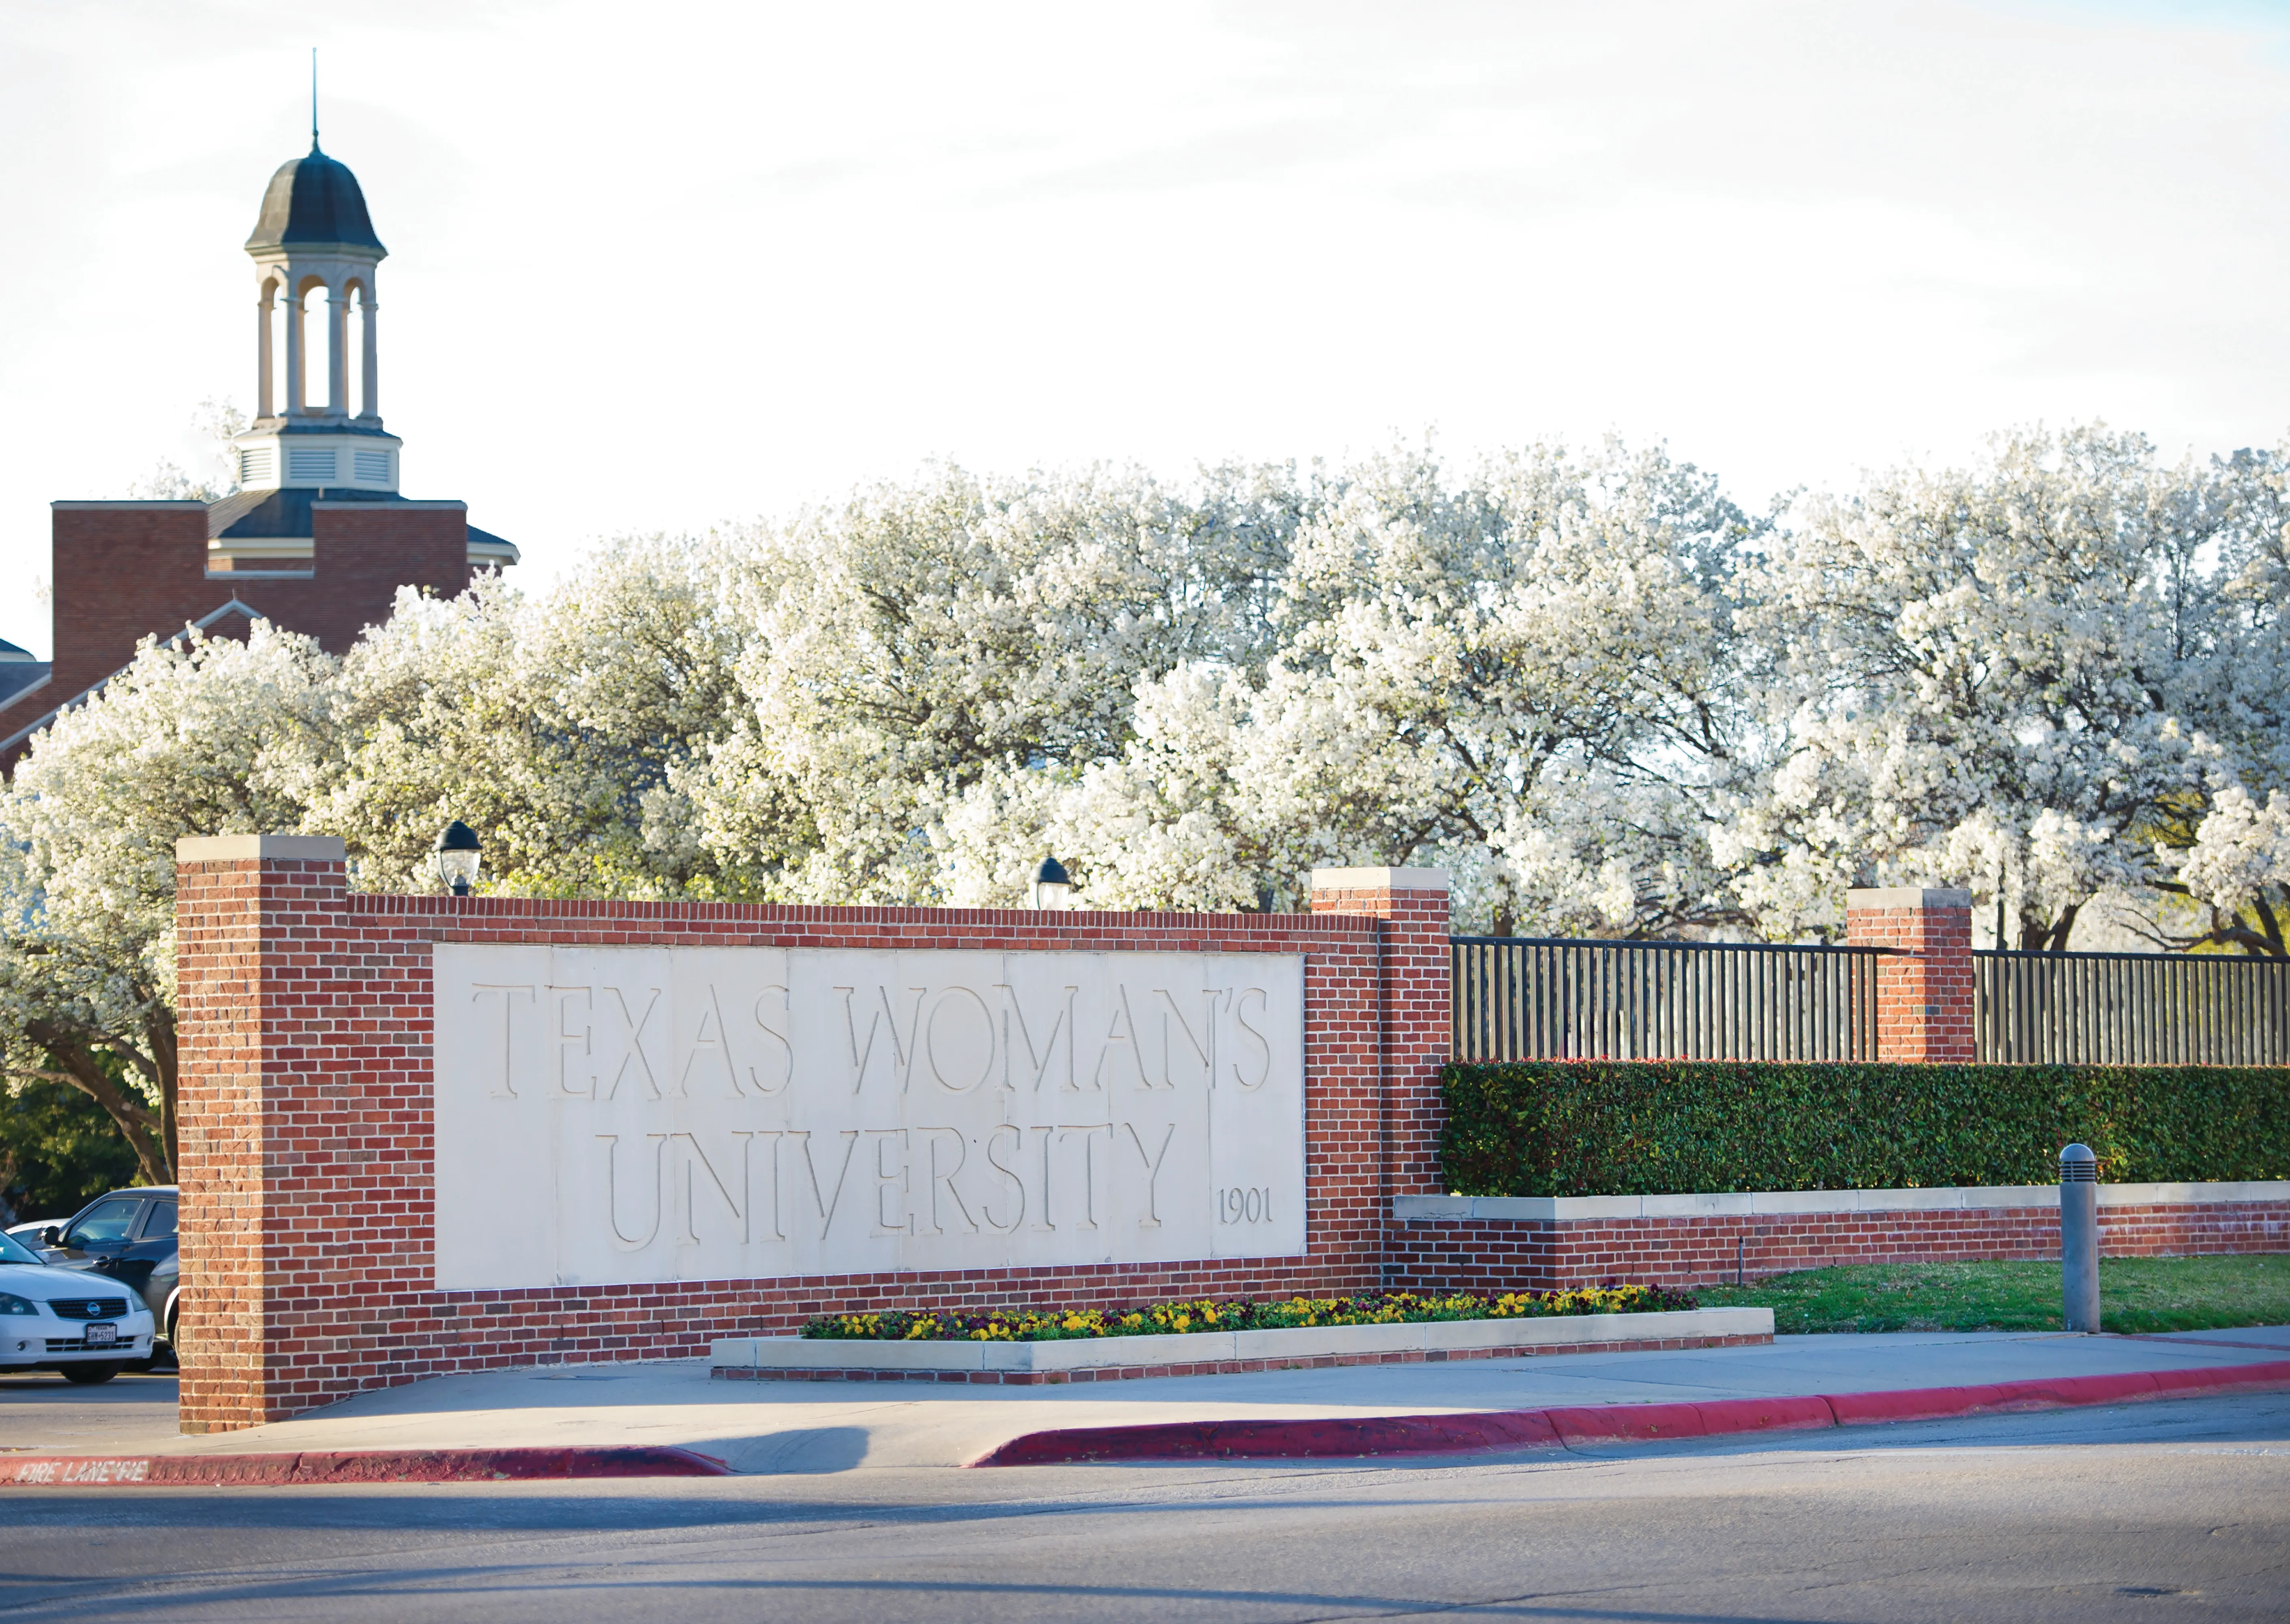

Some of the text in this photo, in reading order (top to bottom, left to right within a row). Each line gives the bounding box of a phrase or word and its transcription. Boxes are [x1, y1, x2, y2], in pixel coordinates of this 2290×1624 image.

[472, 983, 1270, 1101] TEXAS WOMAN'S
[595, 1123, 1175, 1252] UNIVERSITY
[1216, 1187, 1273, 1225] 1901
[17, 1462, 62, 1482] FIRE
[62, 1461, 115, 1482] LANE
